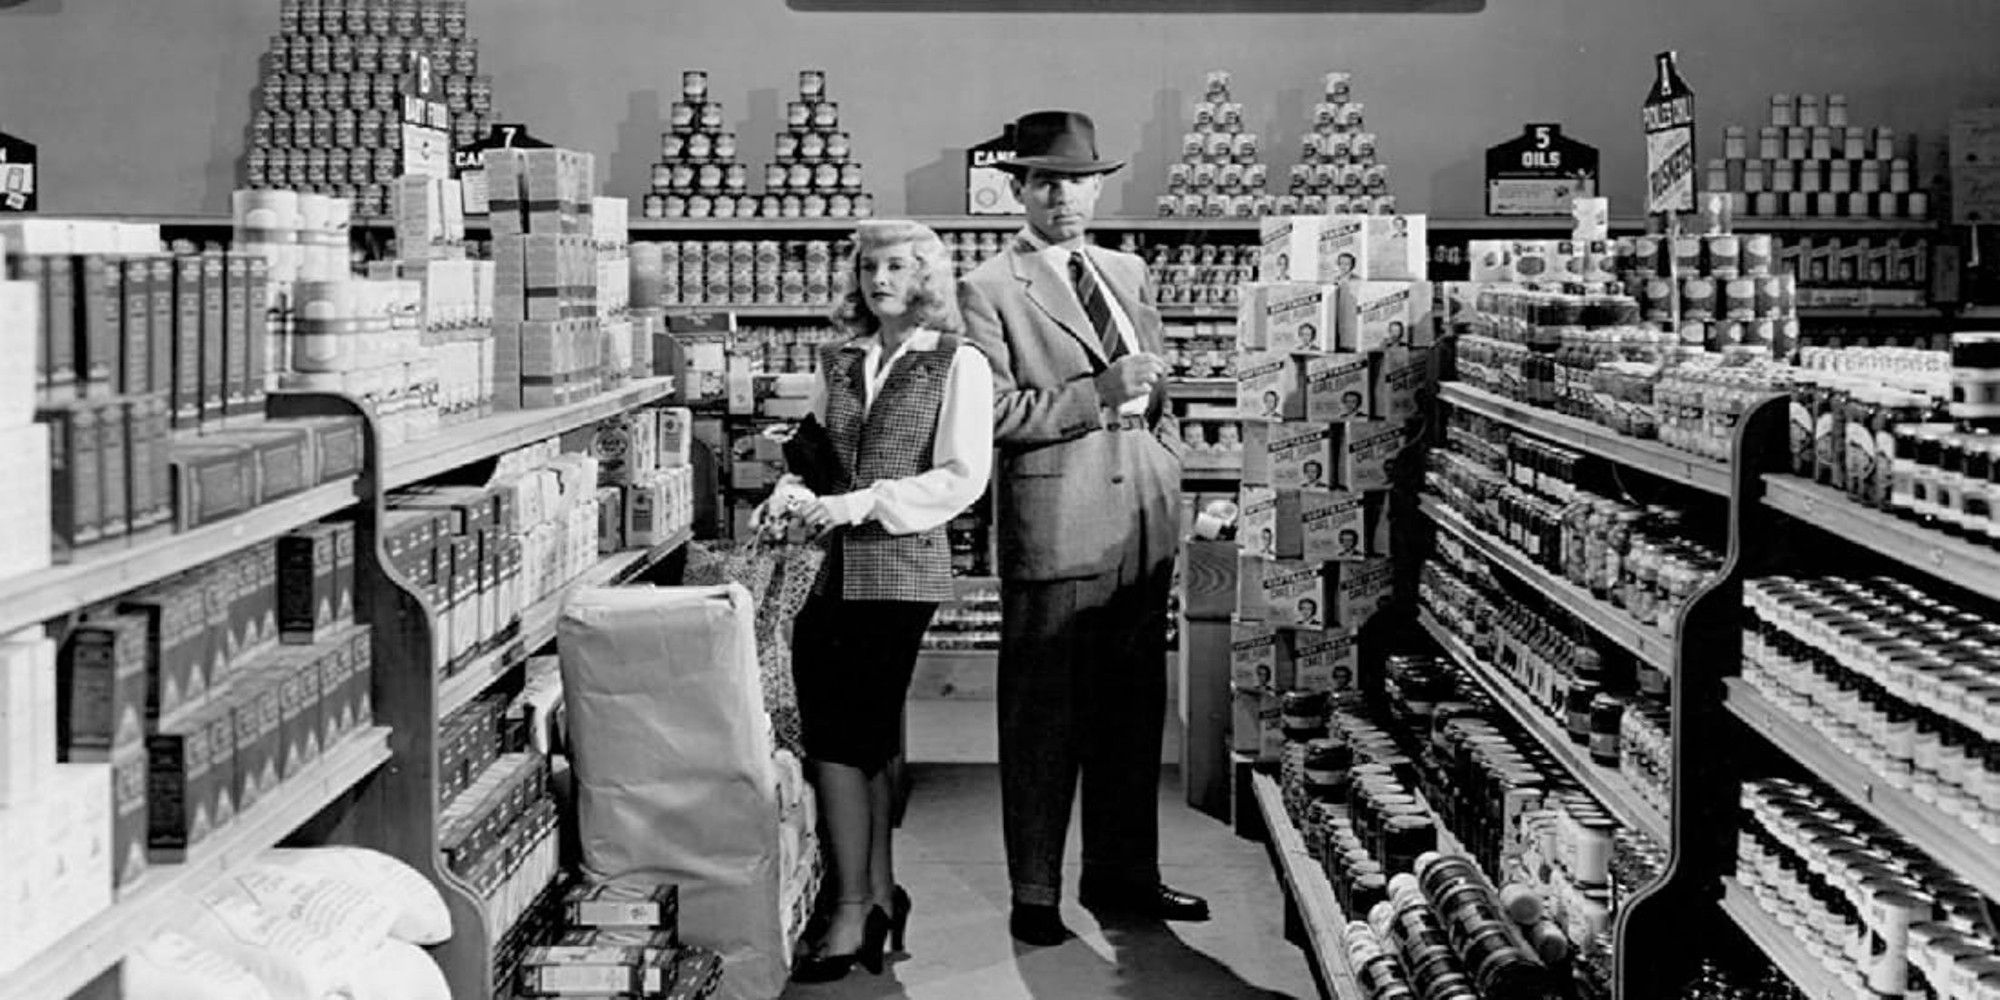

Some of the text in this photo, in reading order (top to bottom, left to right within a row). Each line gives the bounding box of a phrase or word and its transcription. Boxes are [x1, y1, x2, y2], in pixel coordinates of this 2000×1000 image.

[502, 127, 516, 150] 7
[1536, 127, 1551, 149] 5
[1522, 151, 1561, 168] OILS
